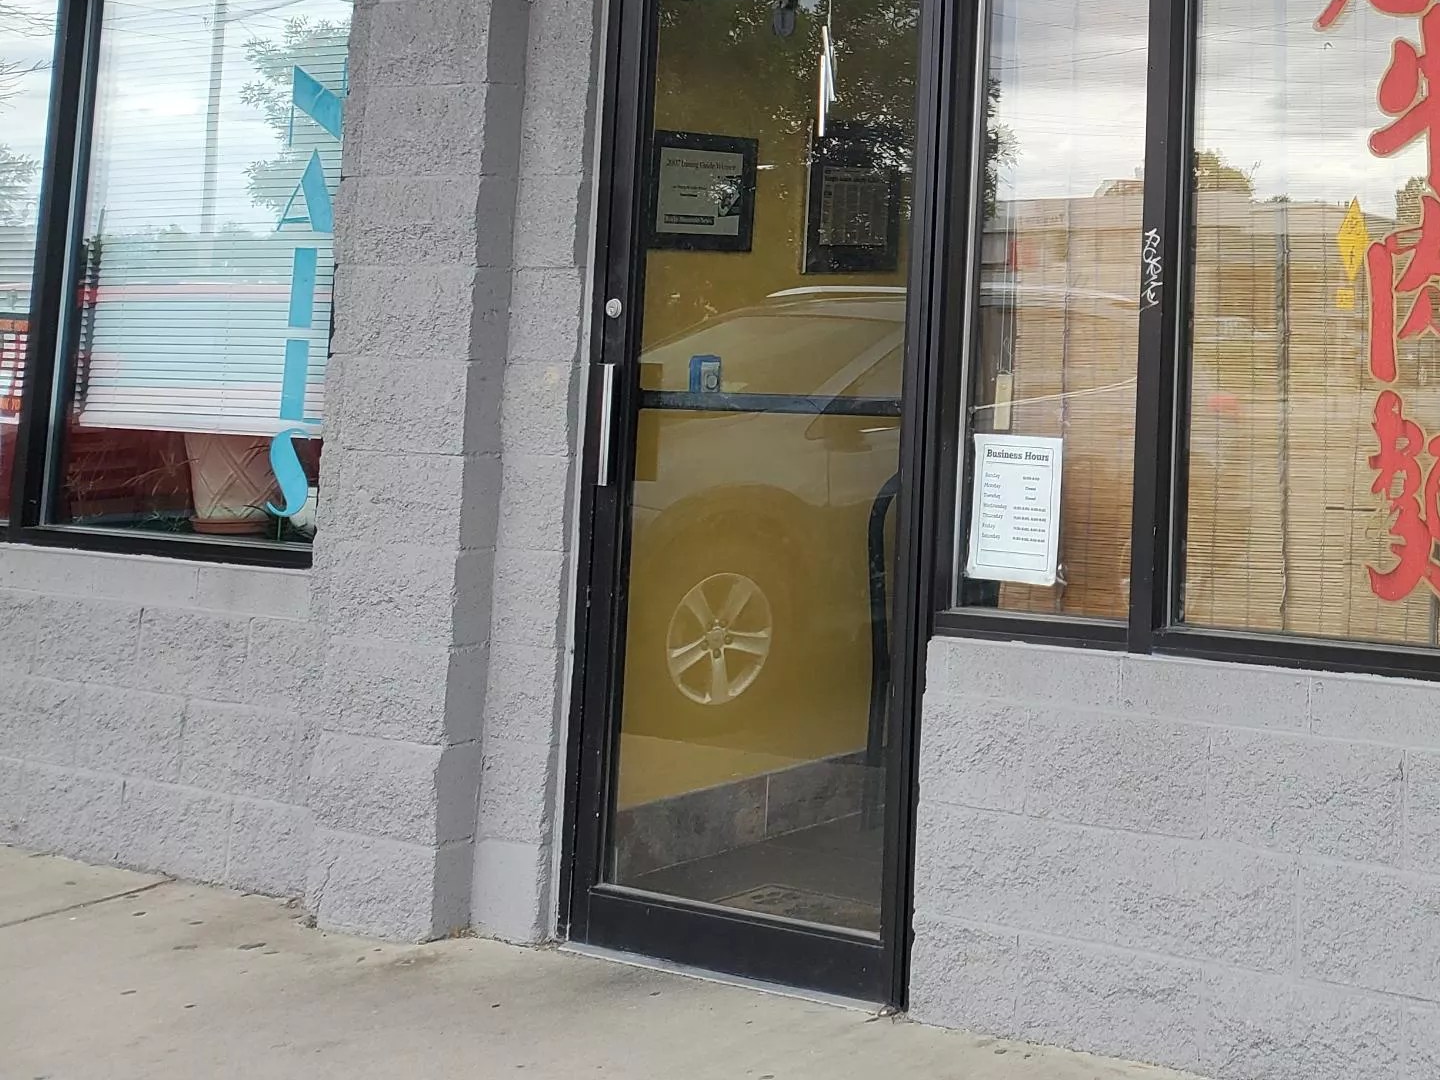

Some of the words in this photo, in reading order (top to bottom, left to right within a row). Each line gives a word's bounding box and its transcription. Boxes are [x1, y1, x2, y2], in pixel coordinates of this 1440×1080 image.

[266, 57, 347, 518] NAILS
[986, 449, 1023, 460] Business
[1024, 451, 1050, 462] Hours
